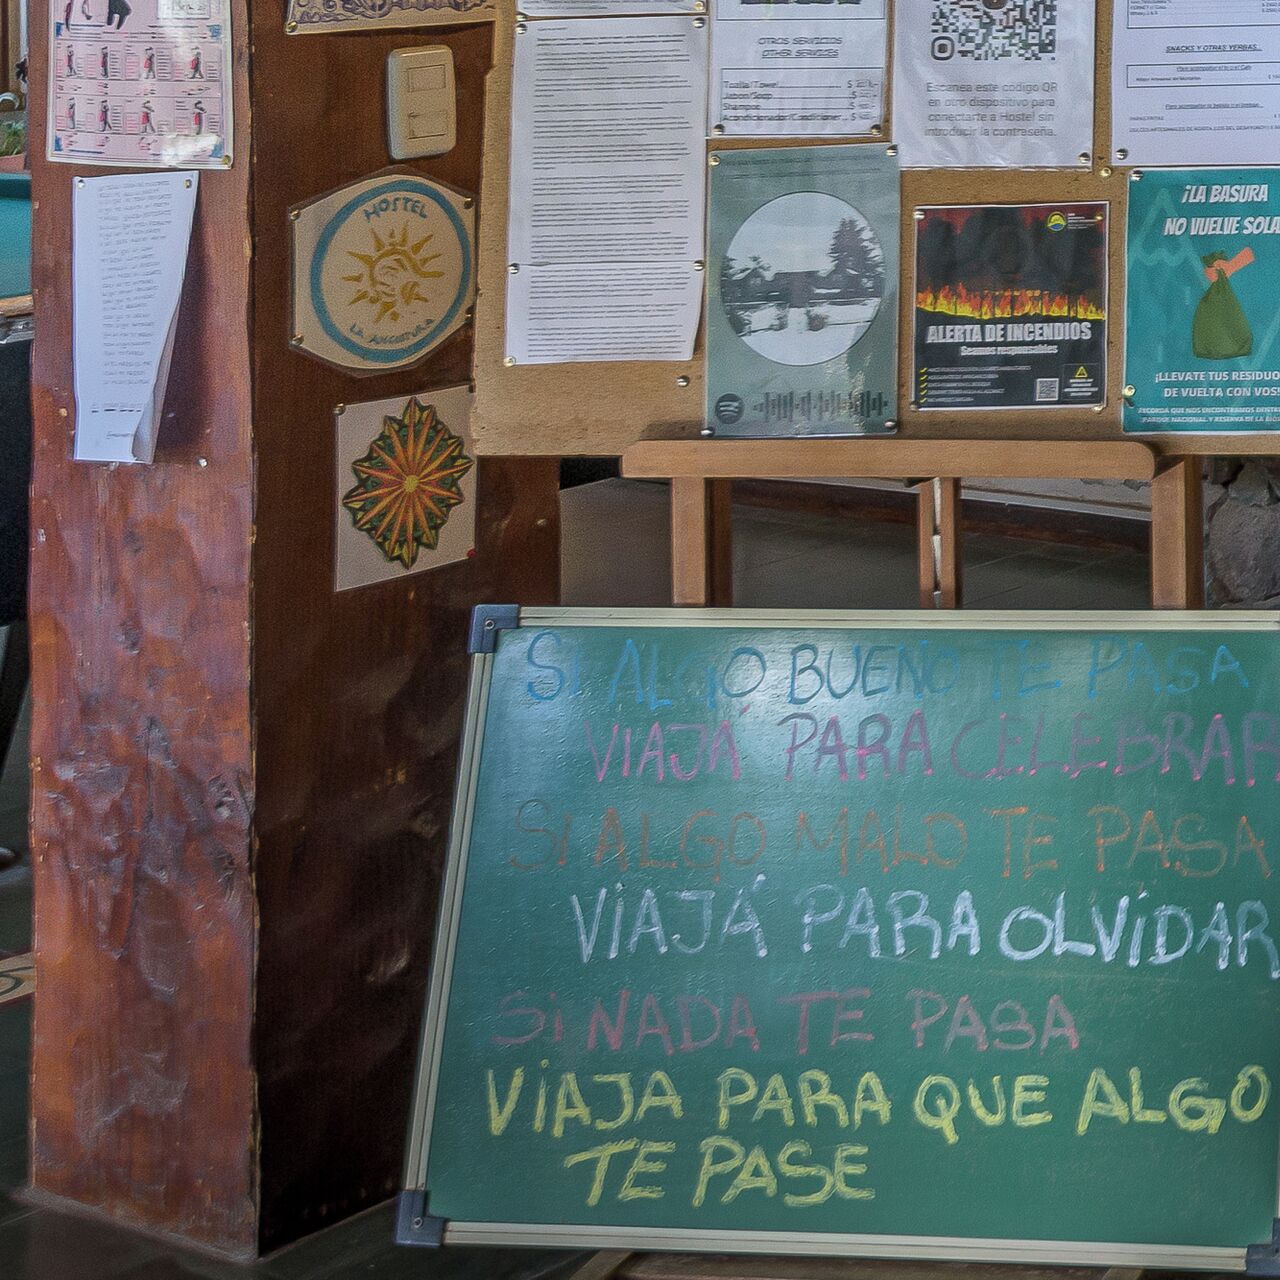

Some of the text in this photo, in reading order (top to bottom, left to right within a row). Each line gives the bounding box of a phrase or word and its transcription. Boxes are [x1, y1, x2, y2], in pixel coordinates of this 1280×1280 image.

[364, 196, 427, 222] HOSTEL
[1182, 184, 1268, 203] ¡LA BASURA
[1163, 218, 1187, 236] NO
[1190, 217, 1241, 235] VUELVE
[927, 321, 1092, 343] ALERTA DE INCENDIOS
[960, 344, 1058, 356] Seamos responsables
[1164, 387, 1280, 398] DE VUELTA CON VOS!
[1209, 371, 1228, 381] TUS
[526, 630, 1249, 711] SI ALGO BUENO TE PASA
[584, 704, 751, 783] VIAJÁ
[777, 709, 934, 782] PARA
[507, 798, 1273, 883] SI ALGO MALO TE PASA
[795, 883, 982, 960] PARA
[587, 988, 761, 1057] NADA
[777, 986, 875, 1057] TE
[905, 987, 1080, 1055] PASA
[716, 1066, 892, 1132] PARA
[913, 1072, 1054, 1145] QUE
[1074, 1063, 1272, 1137] ALGO
[564, 1134, 877, 1209] TE PASE
